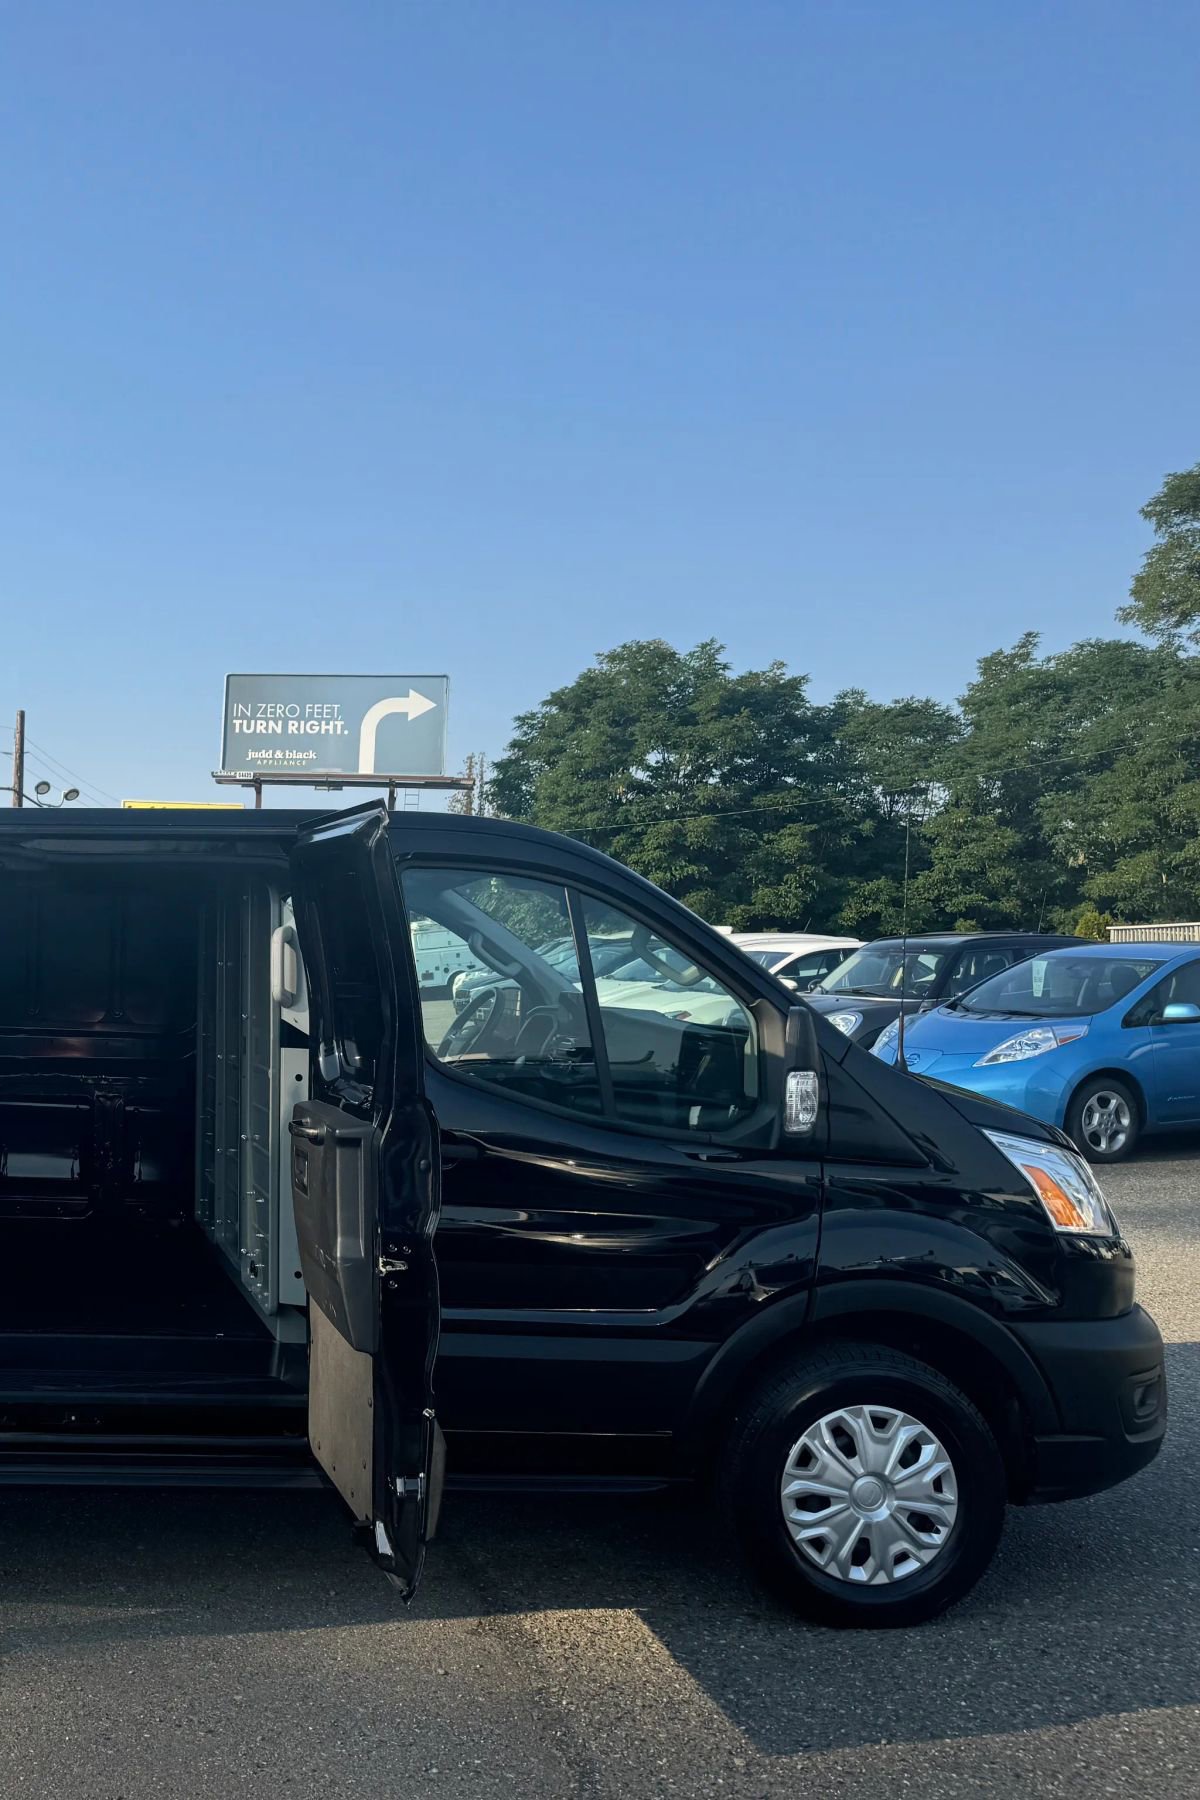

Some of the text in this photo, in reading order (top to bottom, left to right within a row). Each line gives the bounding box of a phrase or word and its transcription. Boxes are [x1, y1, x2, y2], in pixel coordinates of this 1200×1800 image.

[233, 703, 341, 721] IN ZERO FEET,
[233, 719, 349, 735] TURN RIGHT.
[246, 749, 317, 761] judd & black
